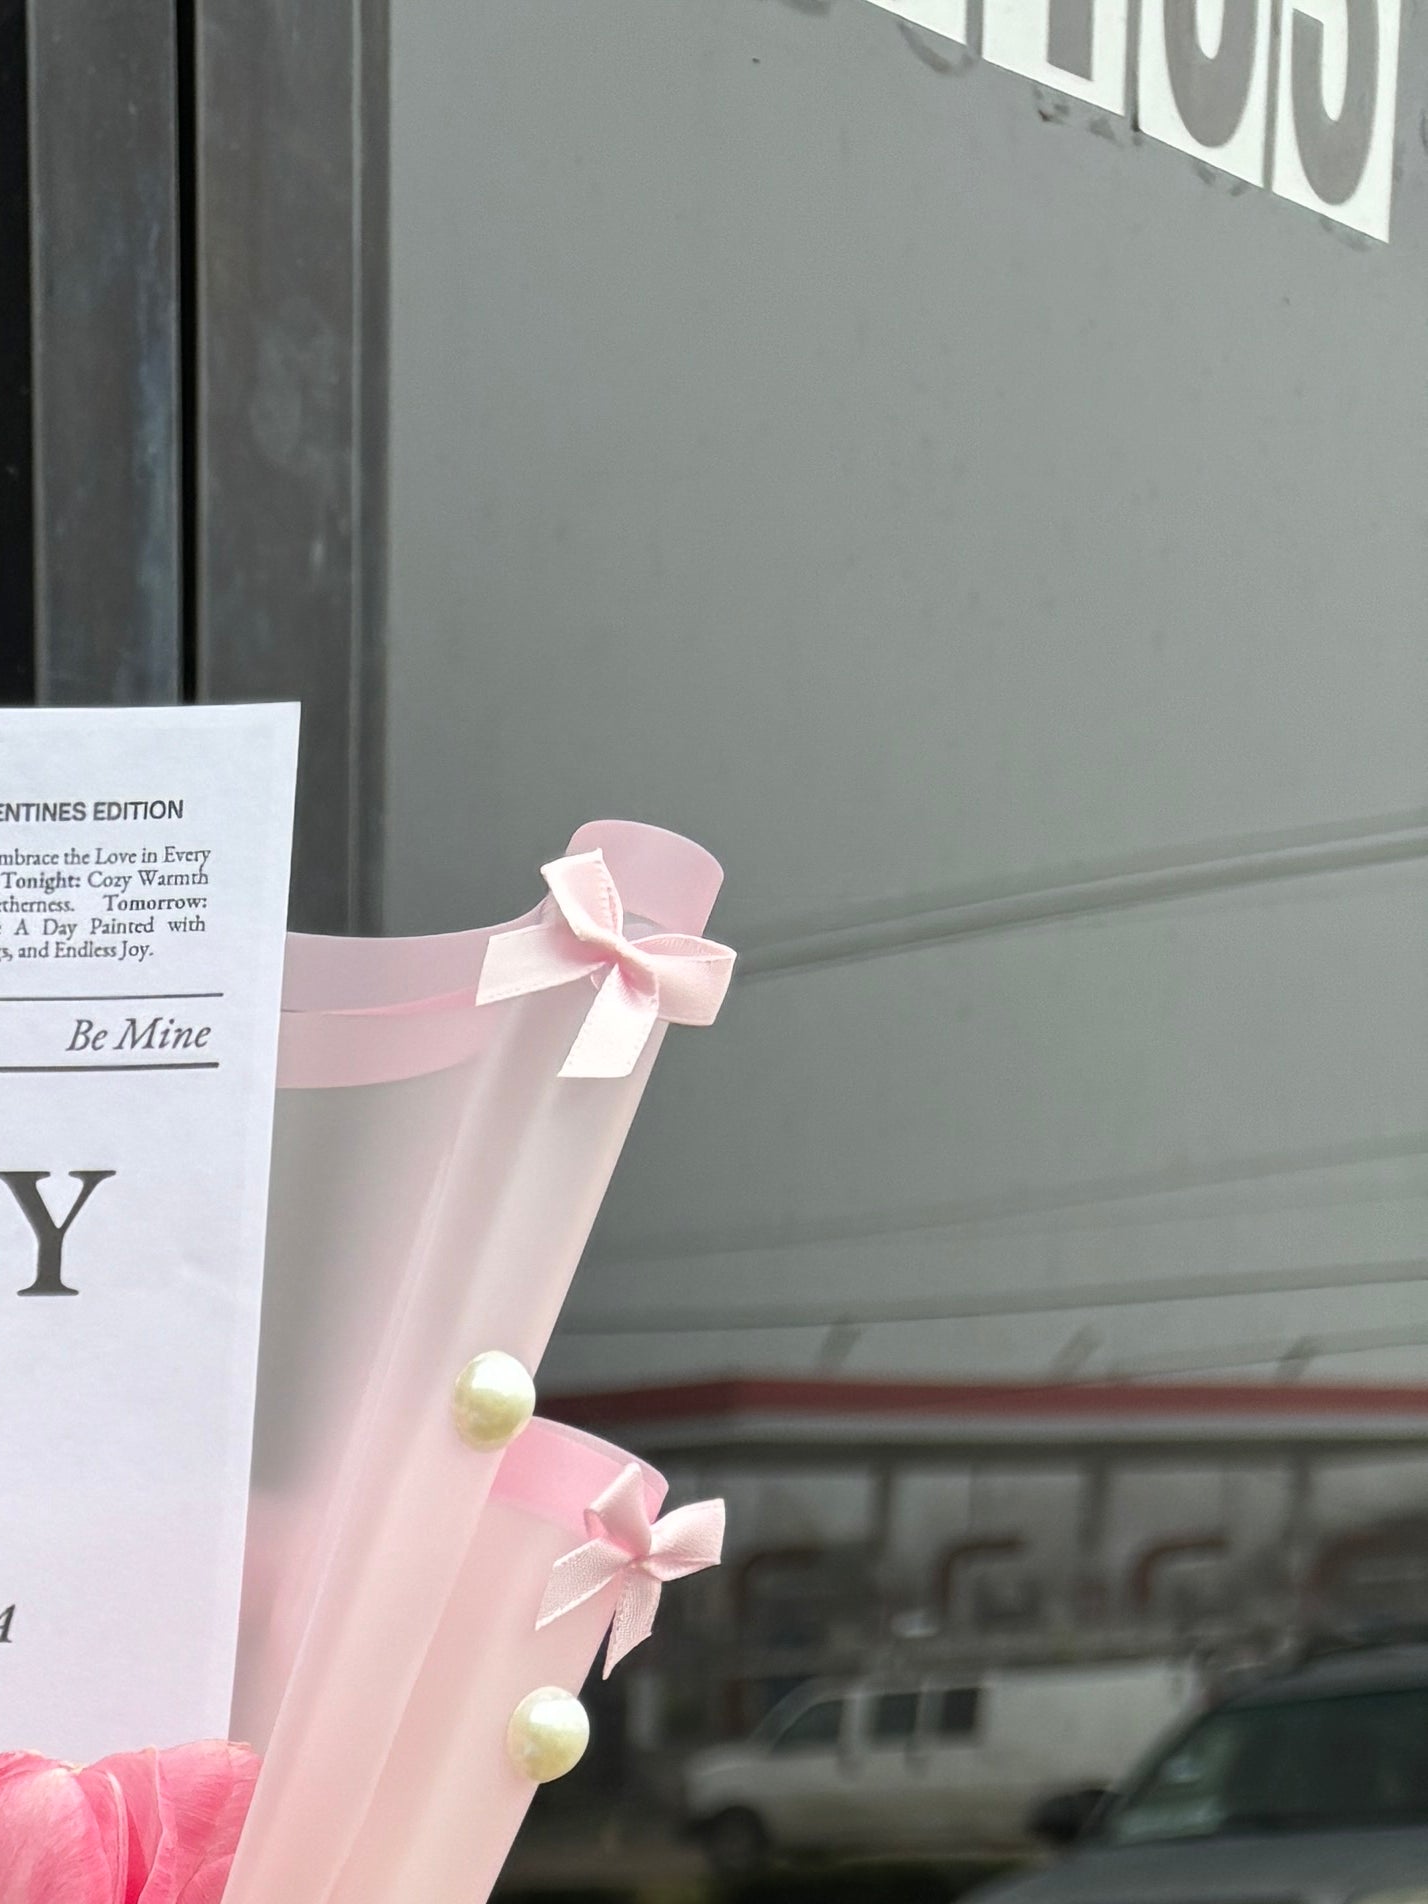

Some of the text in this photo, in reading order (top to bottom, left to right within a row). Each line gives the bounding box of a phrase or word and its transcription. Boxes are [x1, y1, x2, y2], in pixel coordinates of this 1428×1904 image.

[93, 800, 184, 821] EDITION
[64, 850, 90, 865] the
[94, 848, 137, 865] Love
[141, 848, 158, 864] in
[163, 846, 211, 871] Every
[0, 872, 81, 894] Tonight:
[87, 872, 132, 892] Cozy
[138, 868, 209, 887] Warmth
[102, 894, 207, 912] Tomorrow:
[14, 920, 30, 936] A
[43, 919, 77, 940] Day
[90, 917, 155, 936] Painted
[168, 917, 206, 933] with
[18, 941, 49, 959] and
[54, 941, 117, 958] Endless
[118, 940, 154, 962] Joy.
[65, 1017, 211, 1051] Be Mine
